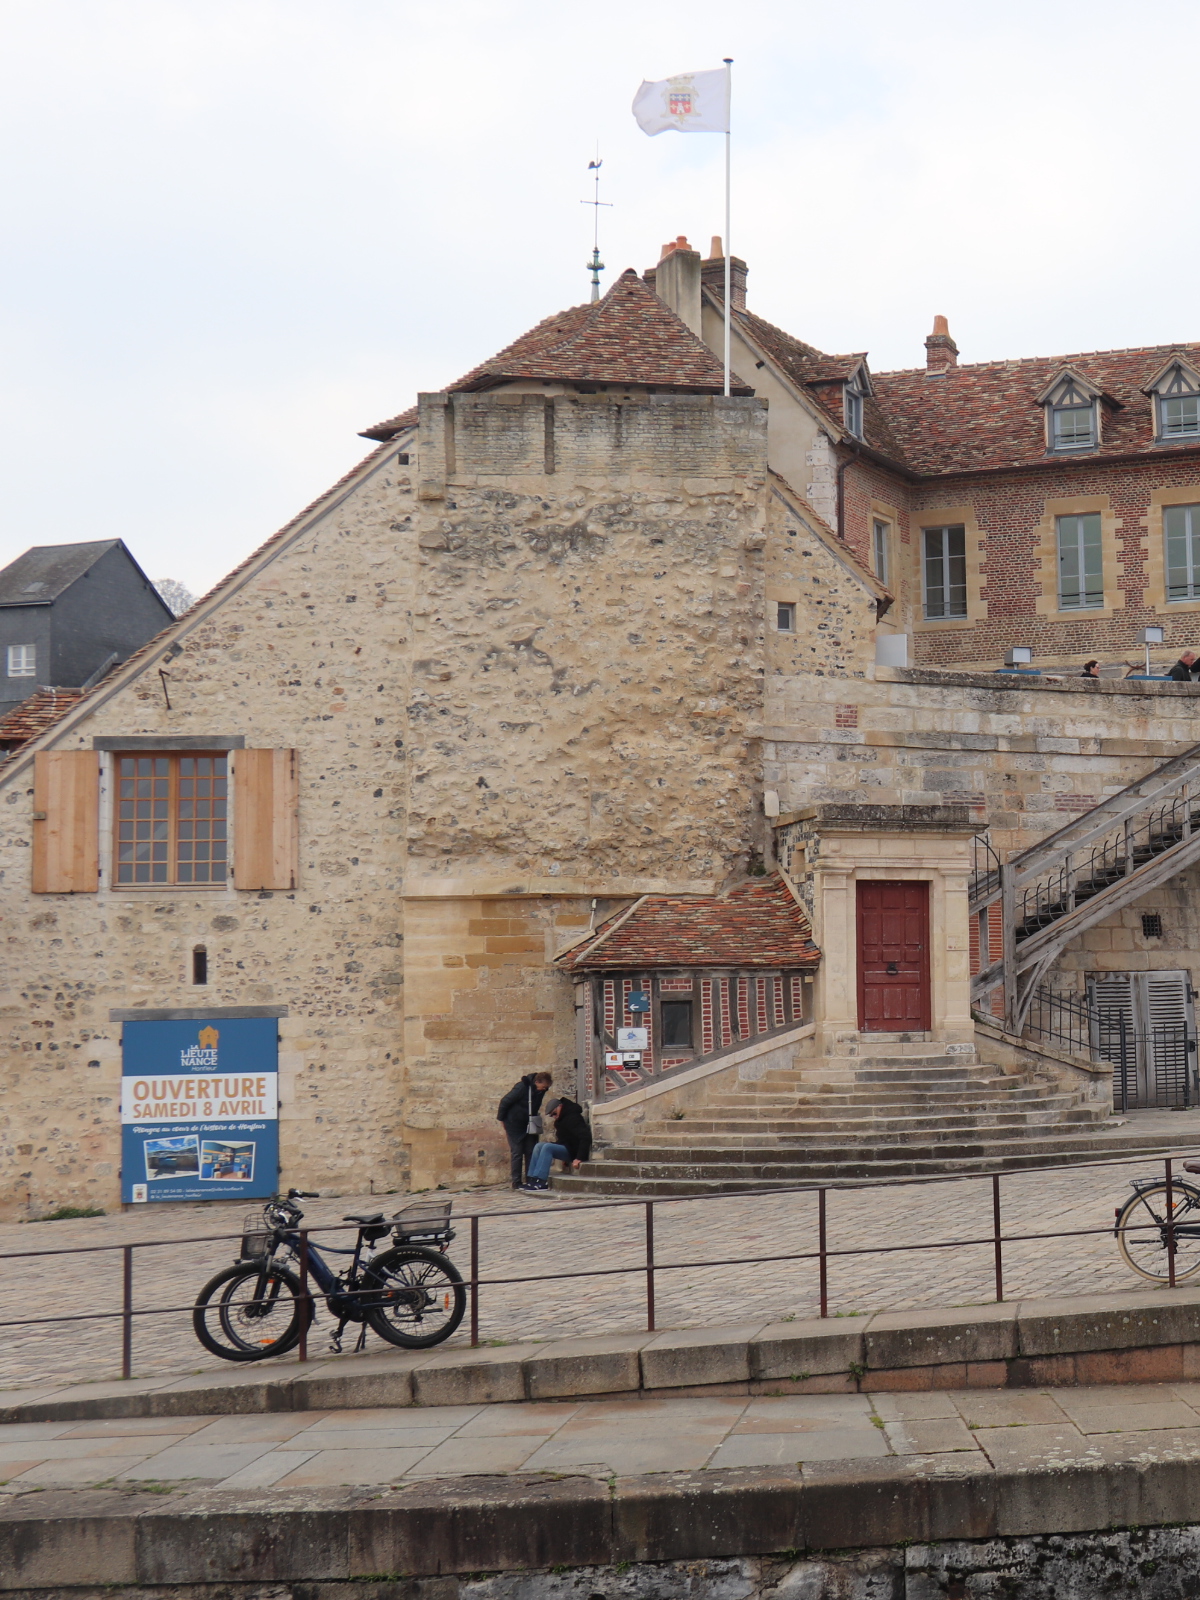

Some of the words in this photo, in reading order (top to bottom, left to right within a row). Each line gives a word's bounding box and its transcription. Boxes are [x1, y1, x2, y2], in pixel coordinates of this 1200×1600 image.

[180, 1049, 218, 1058] LIEUTE
[181, 1057, 218, 1066] NANCE
[133, 1077, 266, 1101] OUVERTURE
[133, 1102, 197, 1118] SAMEDI
[203, 1101, 213, 1116] 8
[218, 1100, 266, 1116] AVRIL
